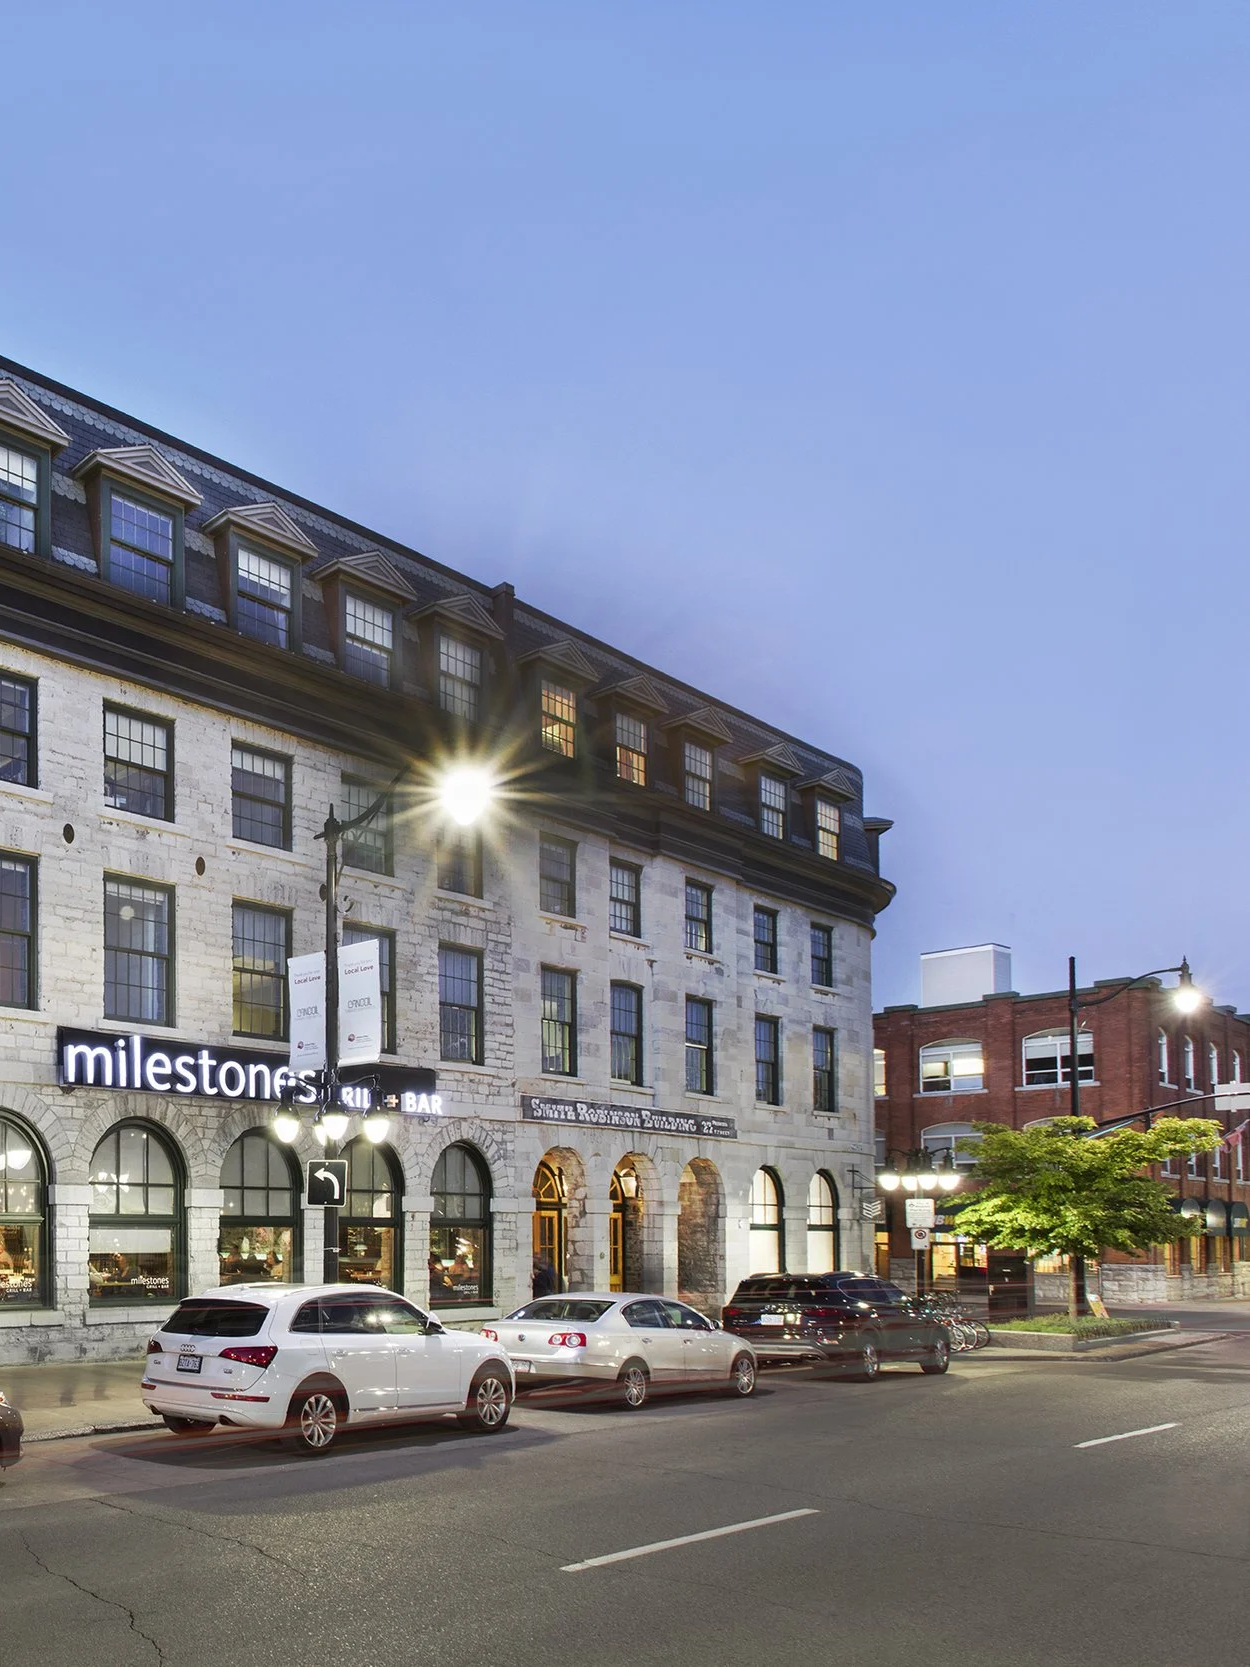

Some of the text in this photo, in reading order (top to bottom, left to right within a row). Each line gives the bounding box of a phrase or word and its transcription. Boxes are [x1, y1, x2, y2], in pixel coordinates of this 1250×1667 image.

[344, 965, 374, 975] Local Love
[294, 977, 308, 985] Local
[64, 1035, 317, 1104] milestones
[401, 1091, 443, 1115] BAR
[131, 1275, 169, 1285] milestones
